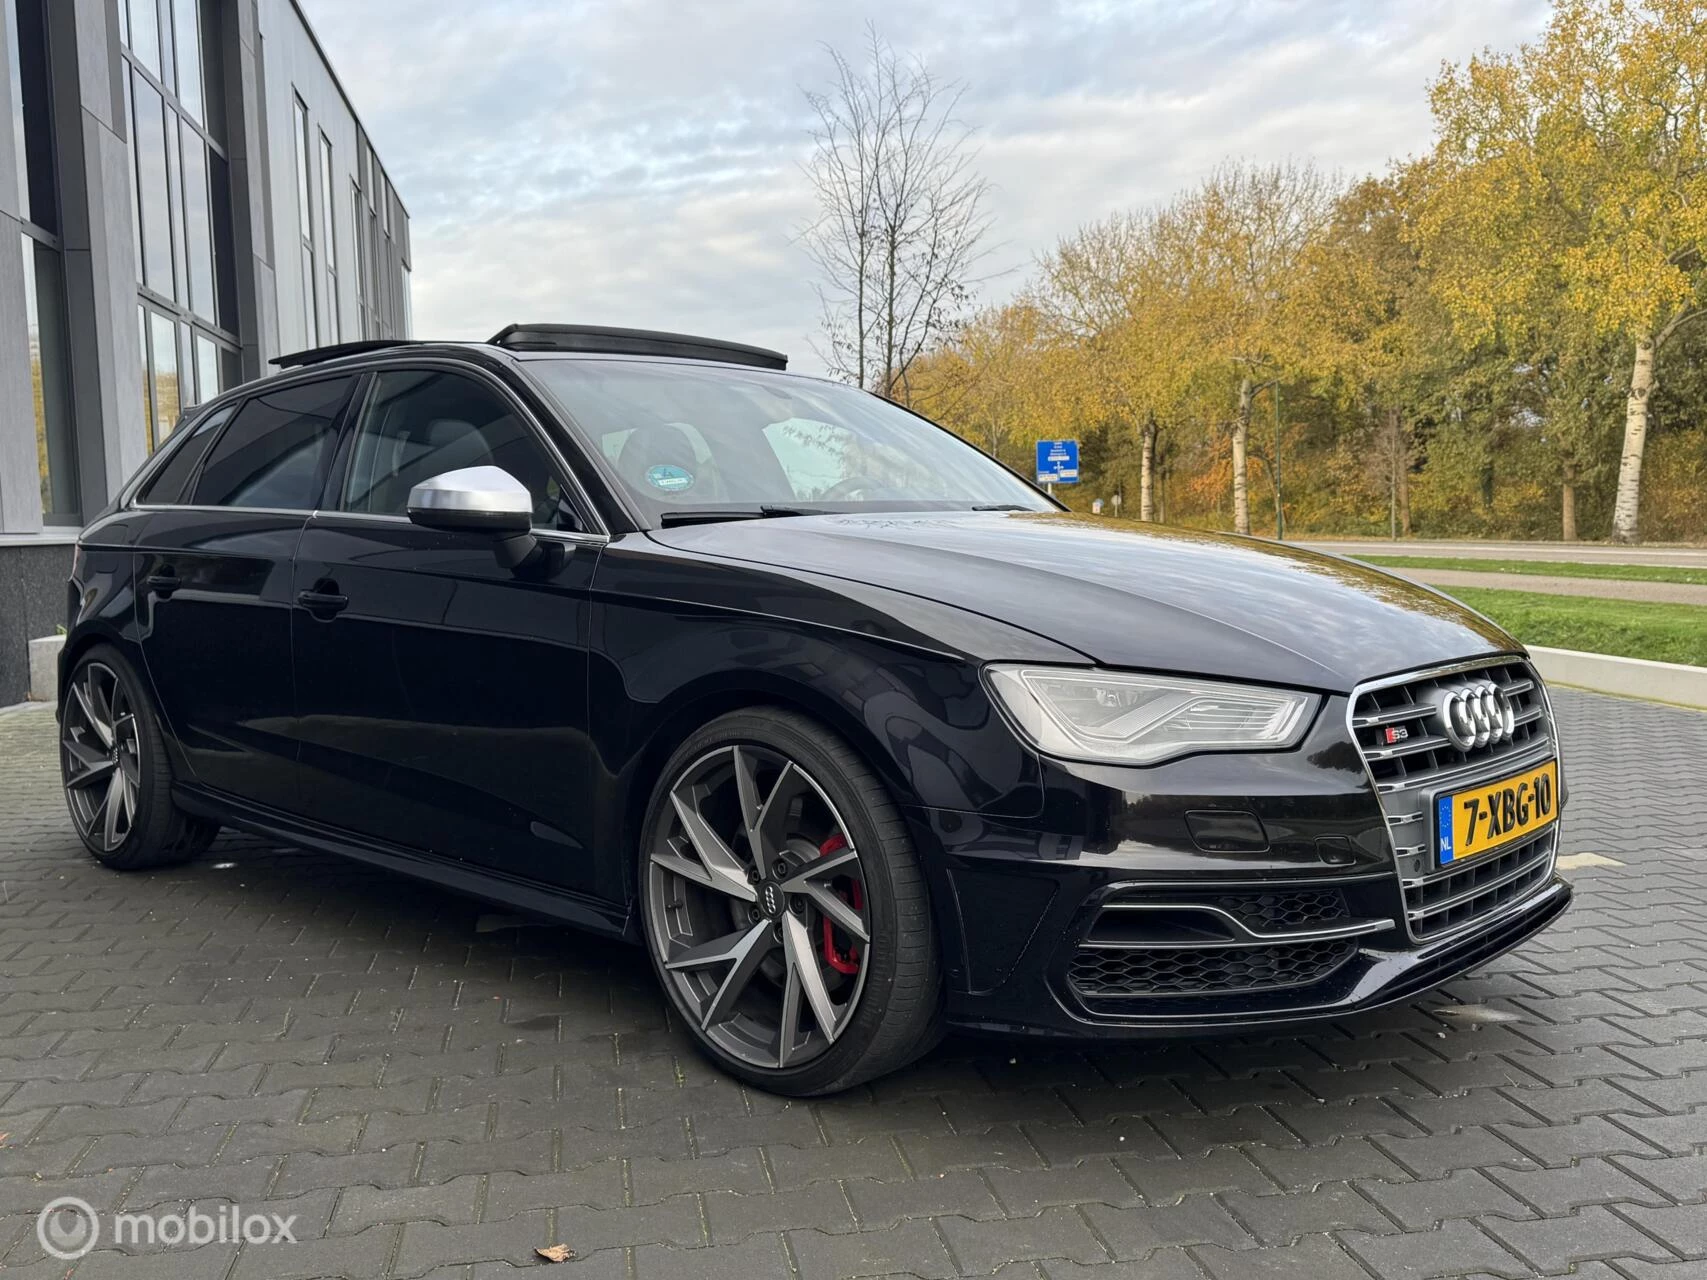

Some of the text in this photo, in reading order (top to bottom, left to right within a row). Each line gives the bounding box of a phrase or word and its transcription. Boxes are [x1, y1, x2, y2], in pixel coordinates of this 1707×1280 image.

[1391, 727, 1408, 740] S3
[1464, 773, 1550, 846] 7-XBG-10
[1440, 837, 1452, 850] NL
